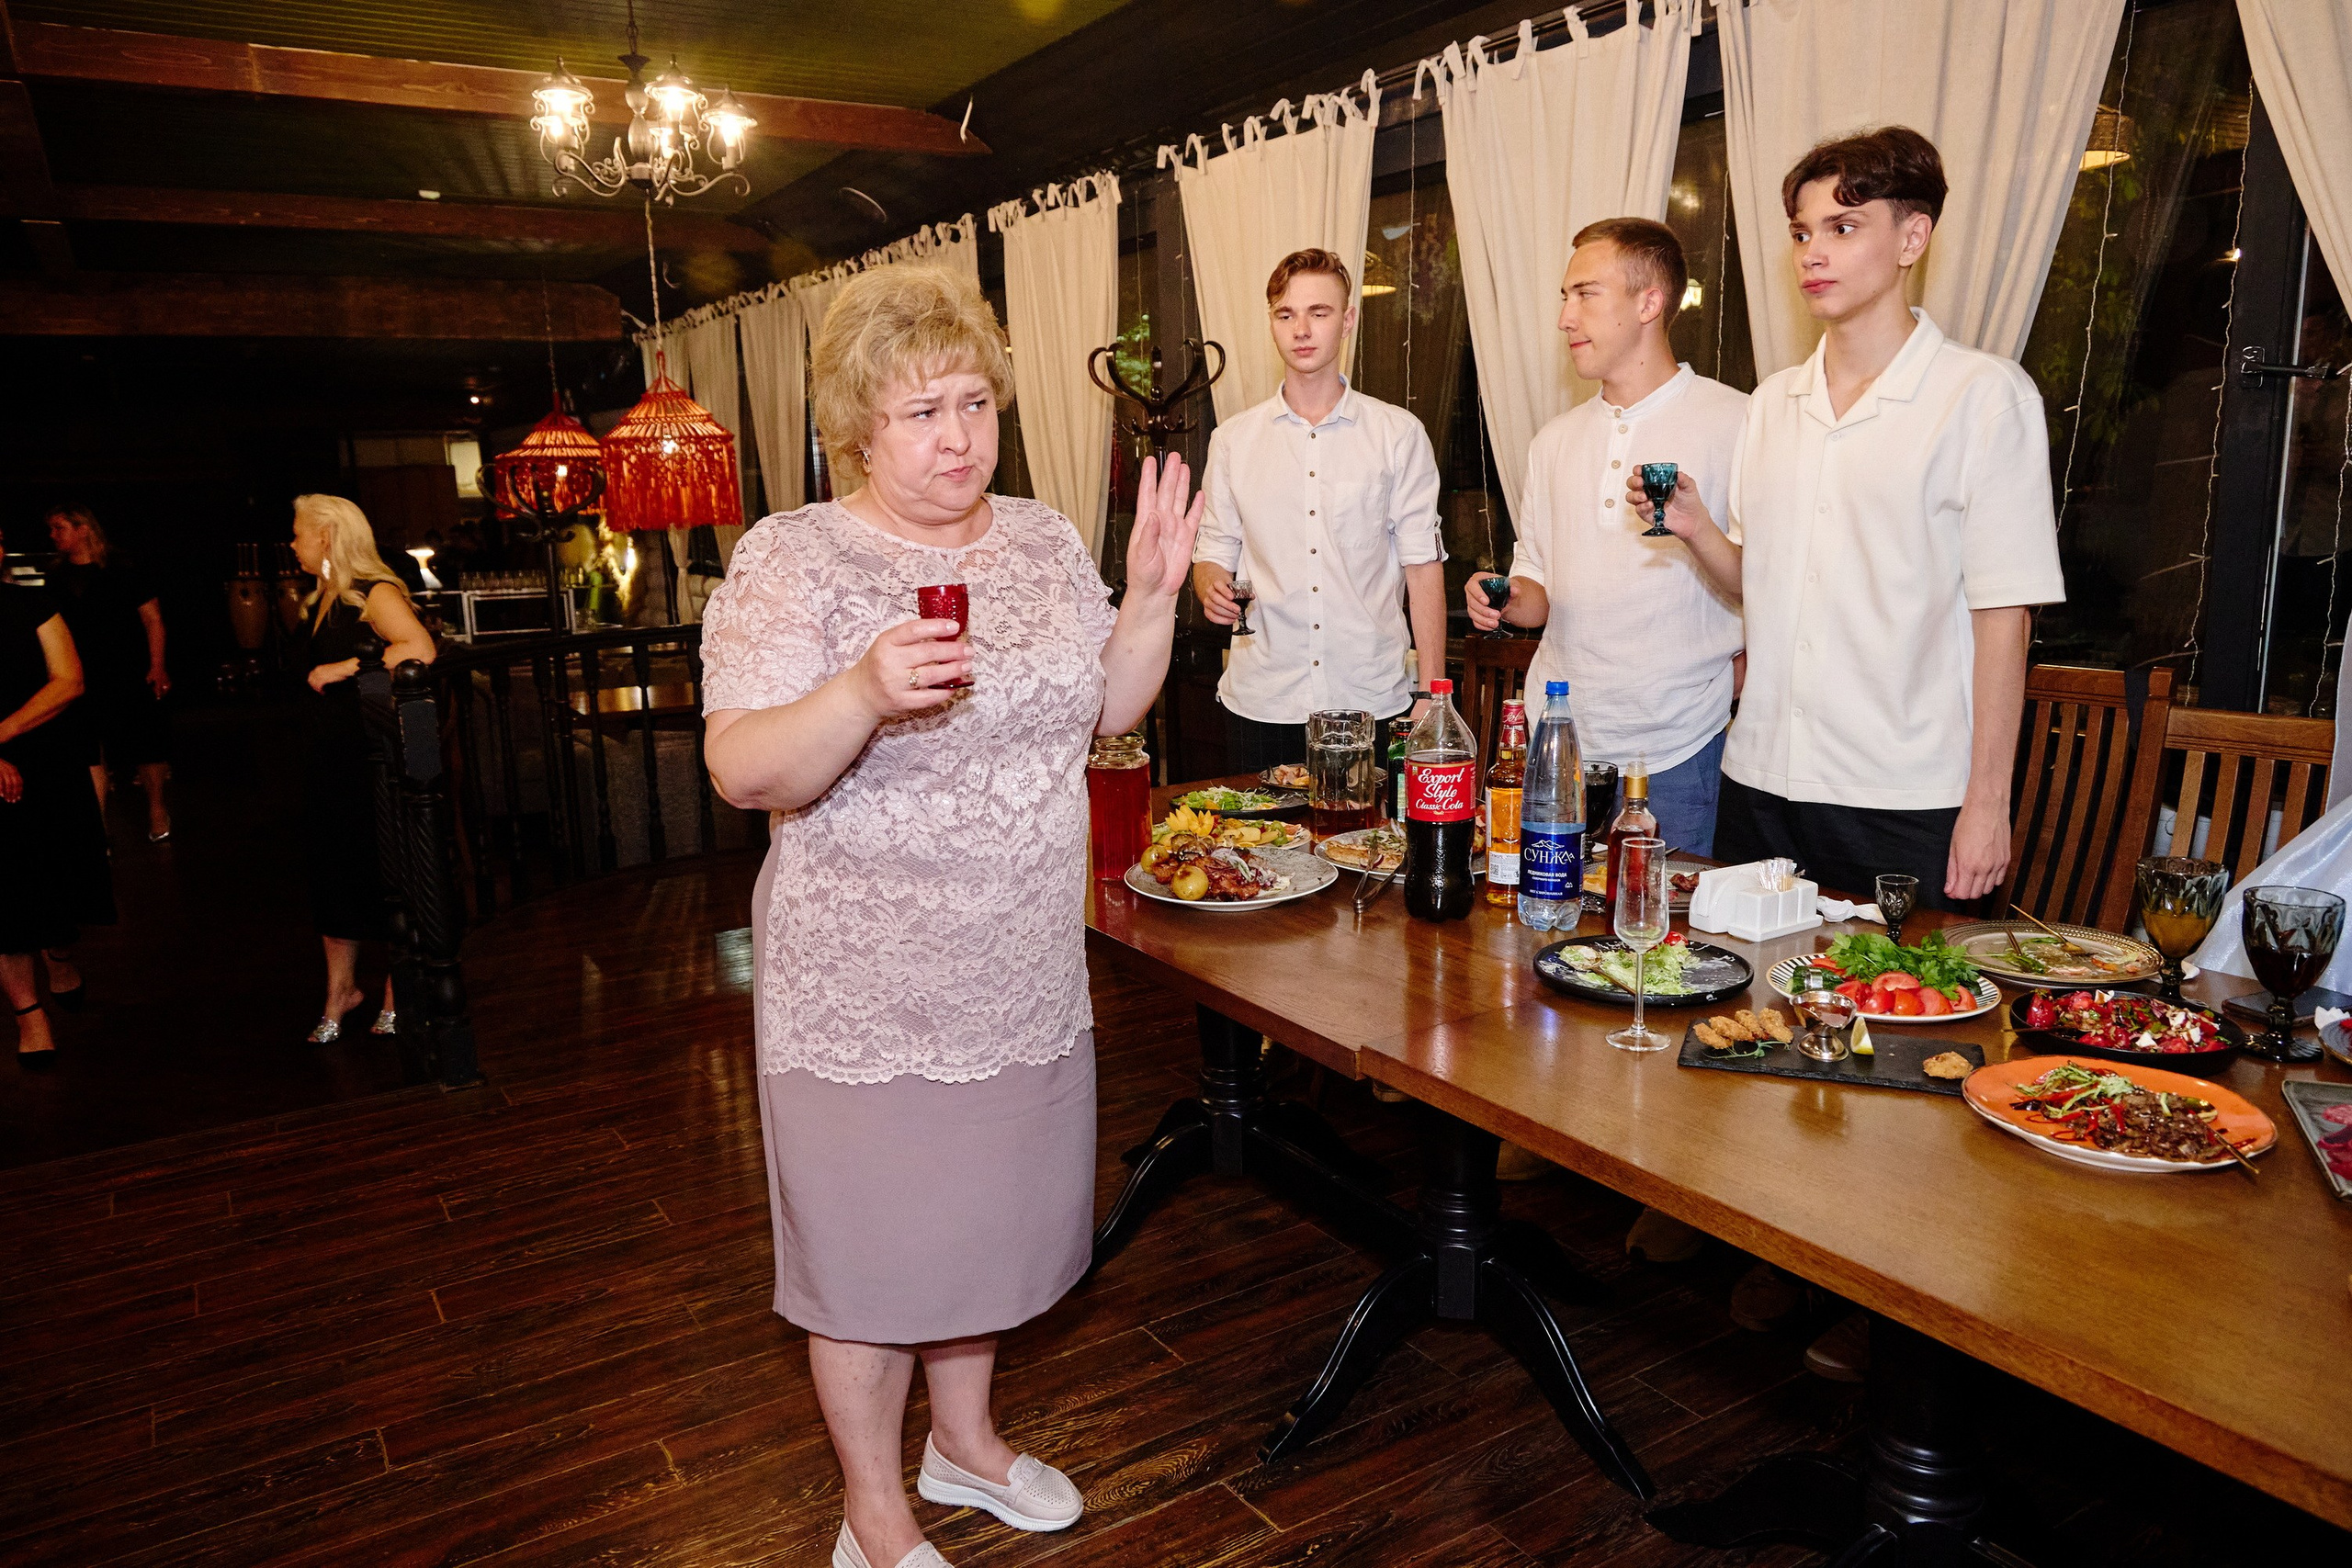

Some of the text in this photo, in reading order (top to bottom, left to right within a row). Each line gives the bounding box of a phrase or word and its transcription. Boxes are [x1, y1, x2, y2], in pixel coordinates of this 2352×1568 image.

[1418, 767, 1465, 791] Export
[1423, 784, 1457, 803] Style
[1416, 797, 1464, 810] Classic Cola
